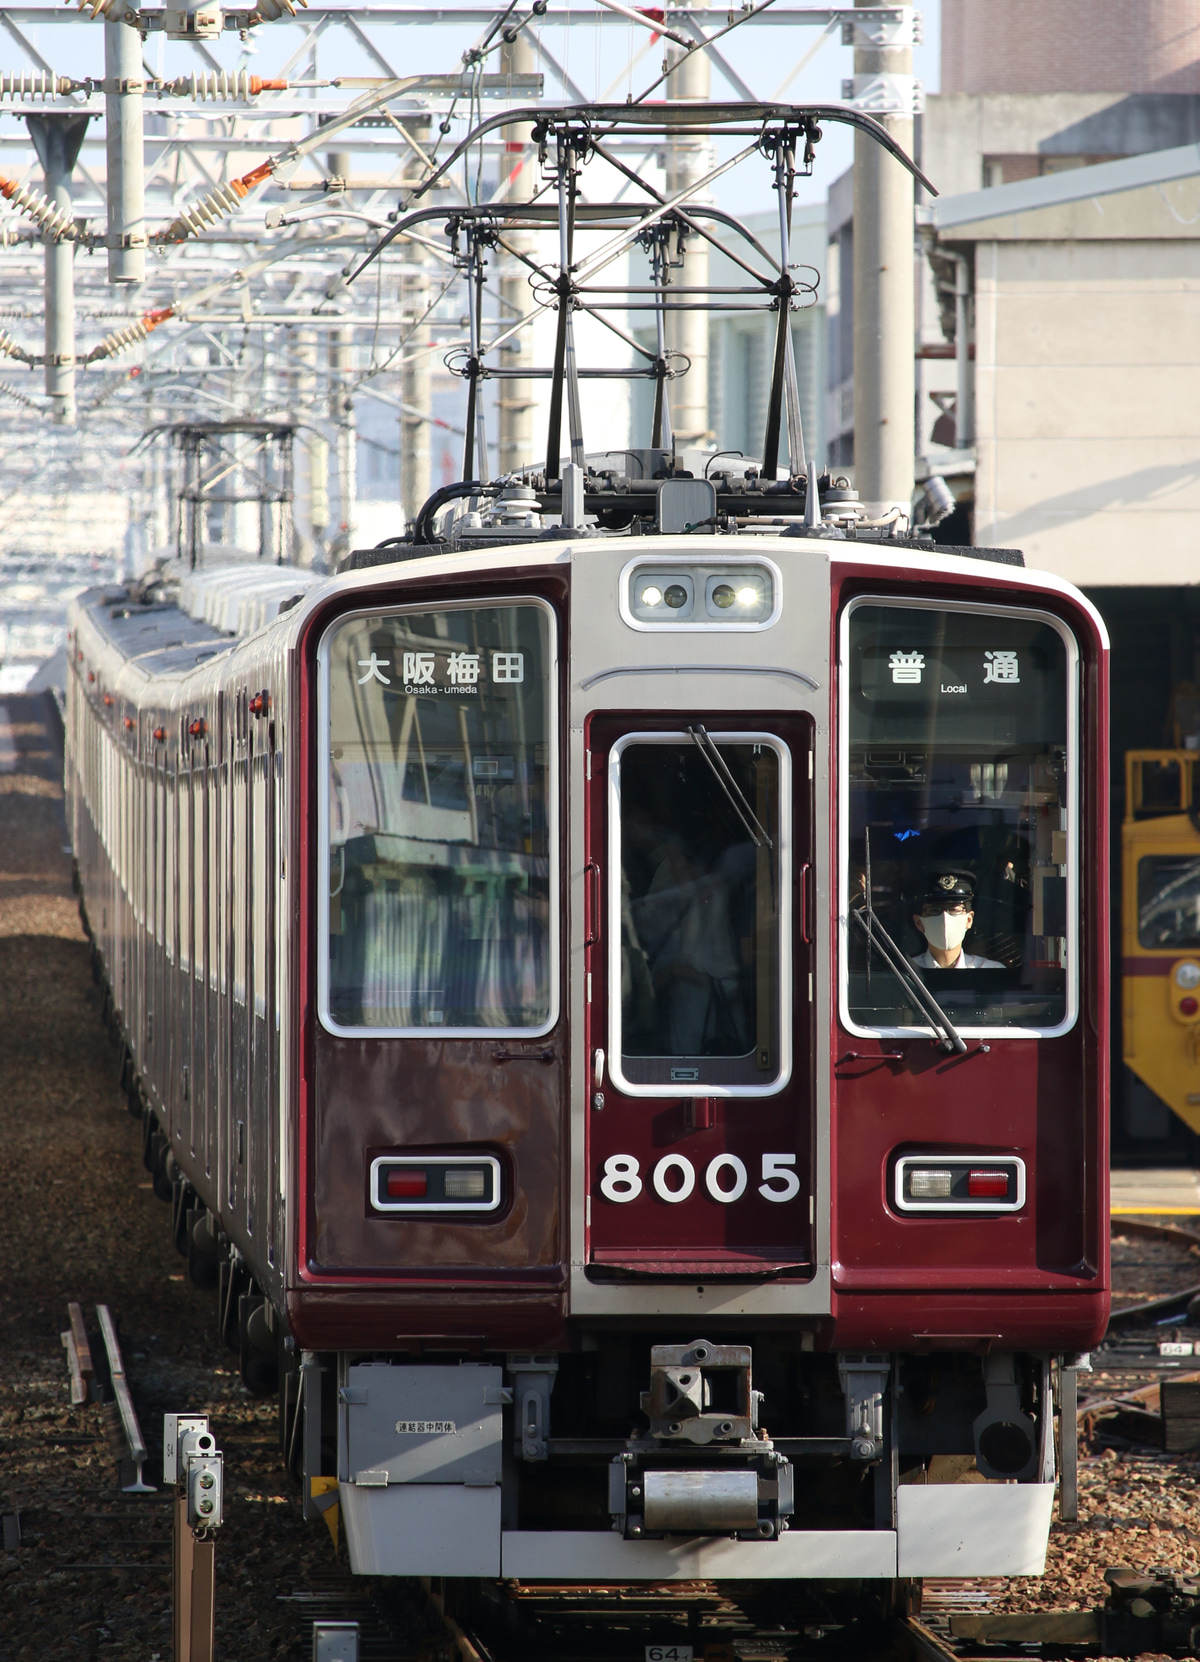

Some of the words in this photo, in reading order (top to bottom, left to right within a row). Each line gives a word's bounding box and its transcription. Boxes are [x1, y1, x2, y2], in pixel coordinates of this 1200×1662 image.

[357, 652, 524, 685] 大阪梅田
[888, 650, 1020, 684] 普通
[404, 684, 478, 694] Osaka-umeda
[940, 683, 968, 694] Local
[600, 1153, 800, 1203] 8005
